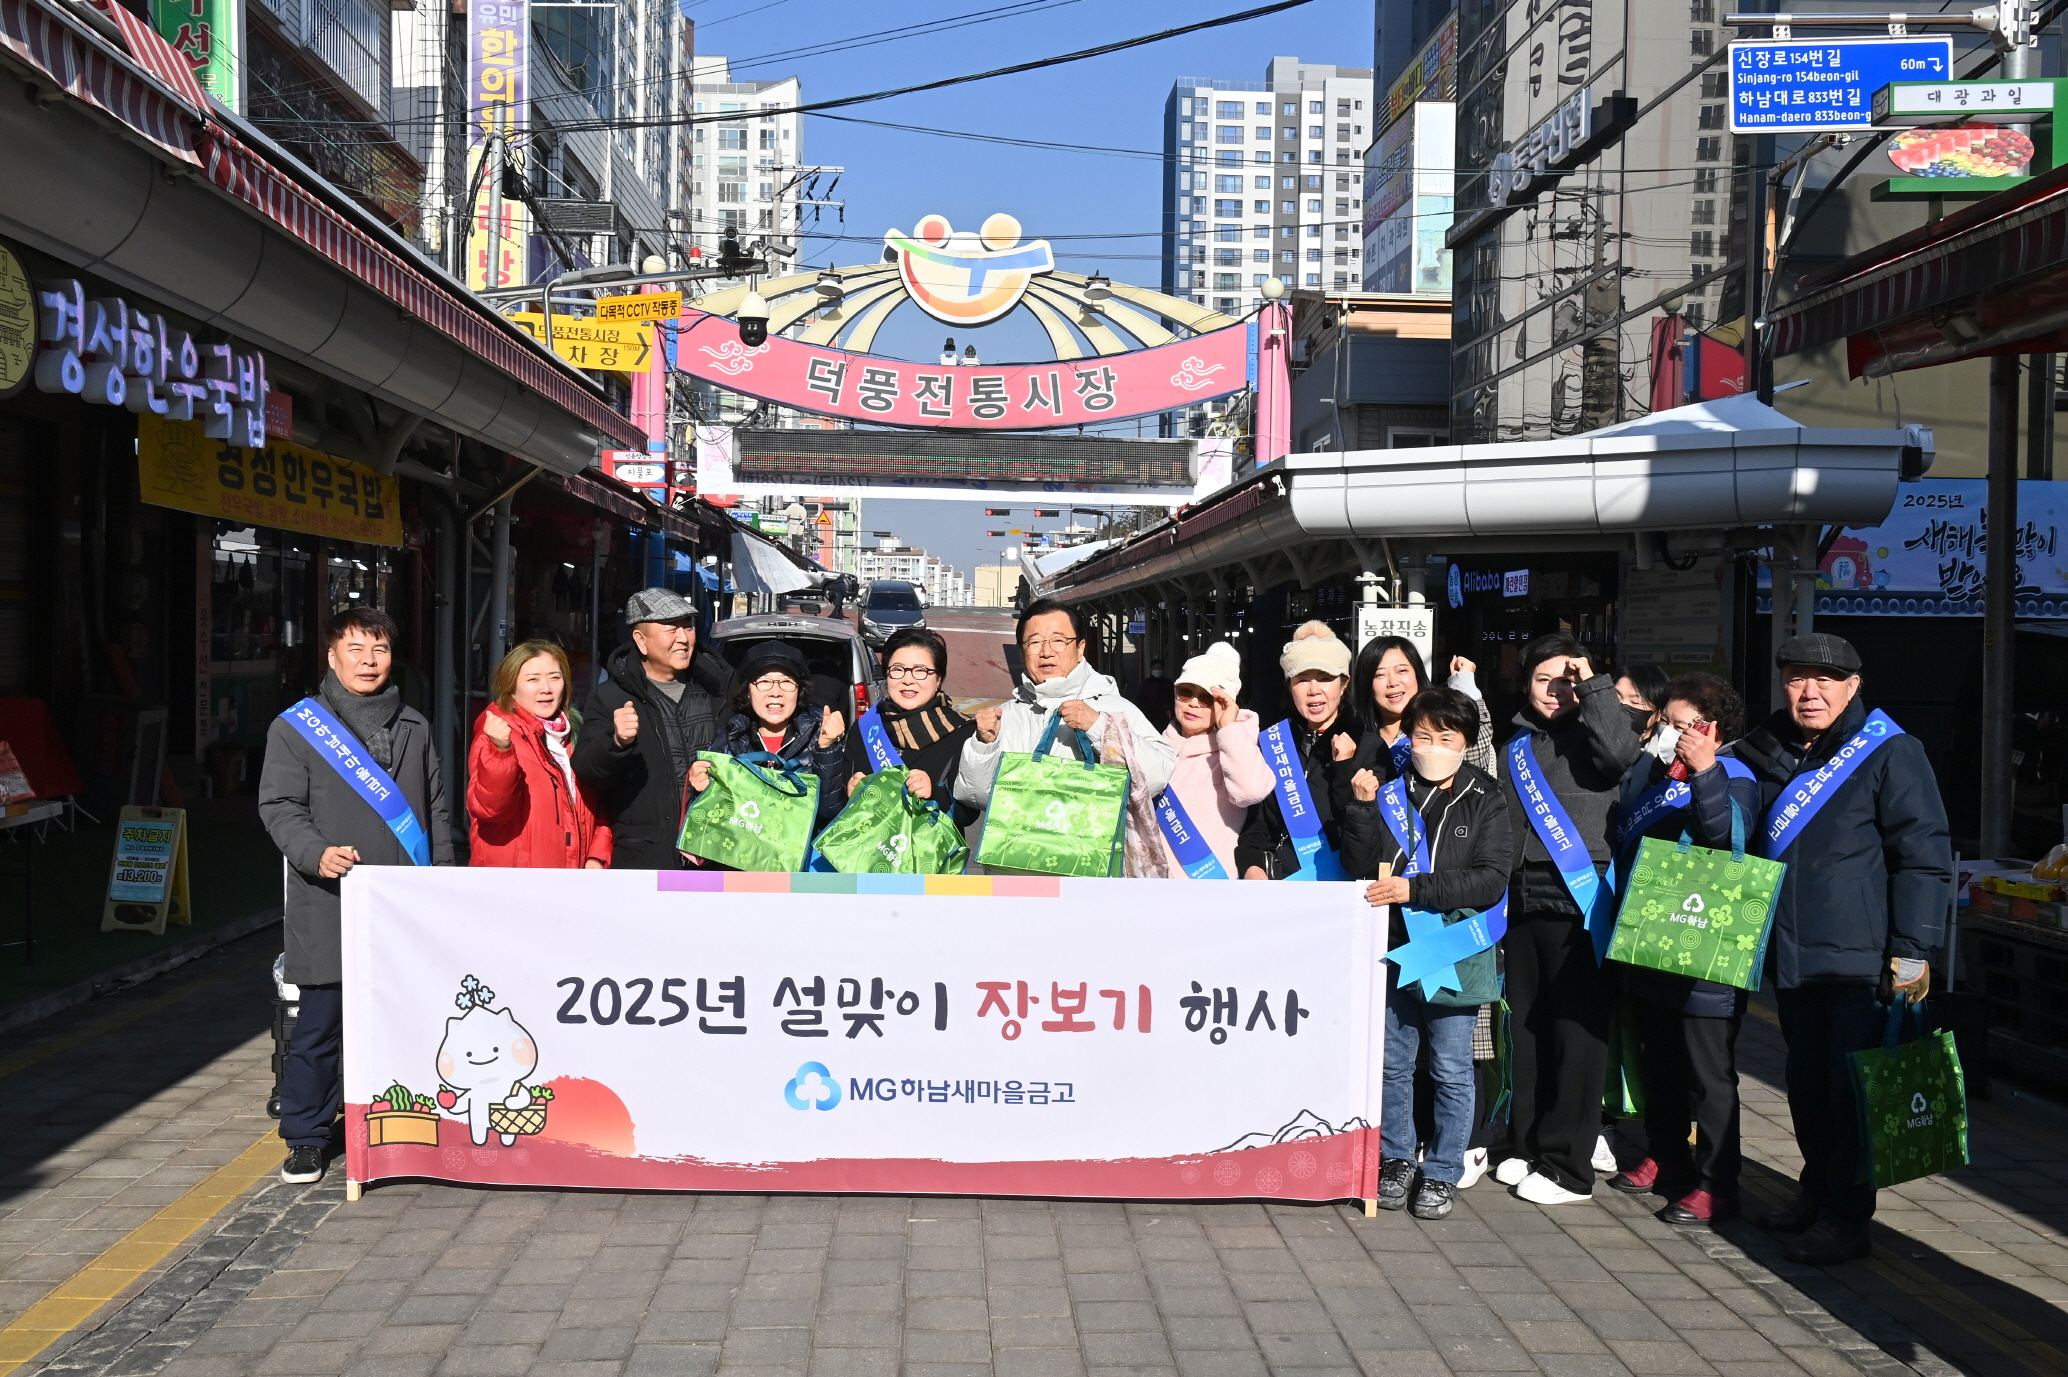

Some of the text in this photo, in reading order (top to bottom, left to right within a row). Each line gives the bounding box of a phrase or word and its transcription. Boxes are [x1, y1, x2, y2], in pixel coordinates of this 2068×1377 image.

[478, 4, 517, 26] 유민
[170, 0, 211, 70] 선
[1900, 59, 1926, 70] 60m
[1737, 70, 1859, 86] Sinjang-ro 154beon-gil
[1927, 87, 2022, 105] 대광과일
[1739, 110, 1871, 124] Hanam-daero 833beon-g
[1512, 88, 1592, 192] 동부신협
[600, 300, 678, 320] 다목적 CCTV 작동중
[43, 279, 271, 448] 경성한우국밥
[806, 356, 1118, 420] 덕풍전통시장
[627, 467, 653, 479] 지물포
[1903, 494, 1965, 509] 2025년
[1903, 518, 1973, 558] 새해
[1463, 569, 1501, 593] Alibaba
[1363, 619, 1428, 638] 농장직송
[296, 707, 391, 801] MG하남새마을금고
[1770, 736, 1868, 842] MG하남새마을금고
[1514, 749, 1573, 852] MG하남새마을금고
[123, 827, 172, 843] 주차금지
[728, 815, 764, 835] MG하남
[875, 840, 903, 868] MG하남
[1669, 913, 1708, 929] MG하남
[556, 975, 1310, 1045] 2025년 설맞이 장보기 행사
[850, 1077, 1076, 1105] MG하남새마을금고
[1906, 1113, 1934, 1129] MG하남
